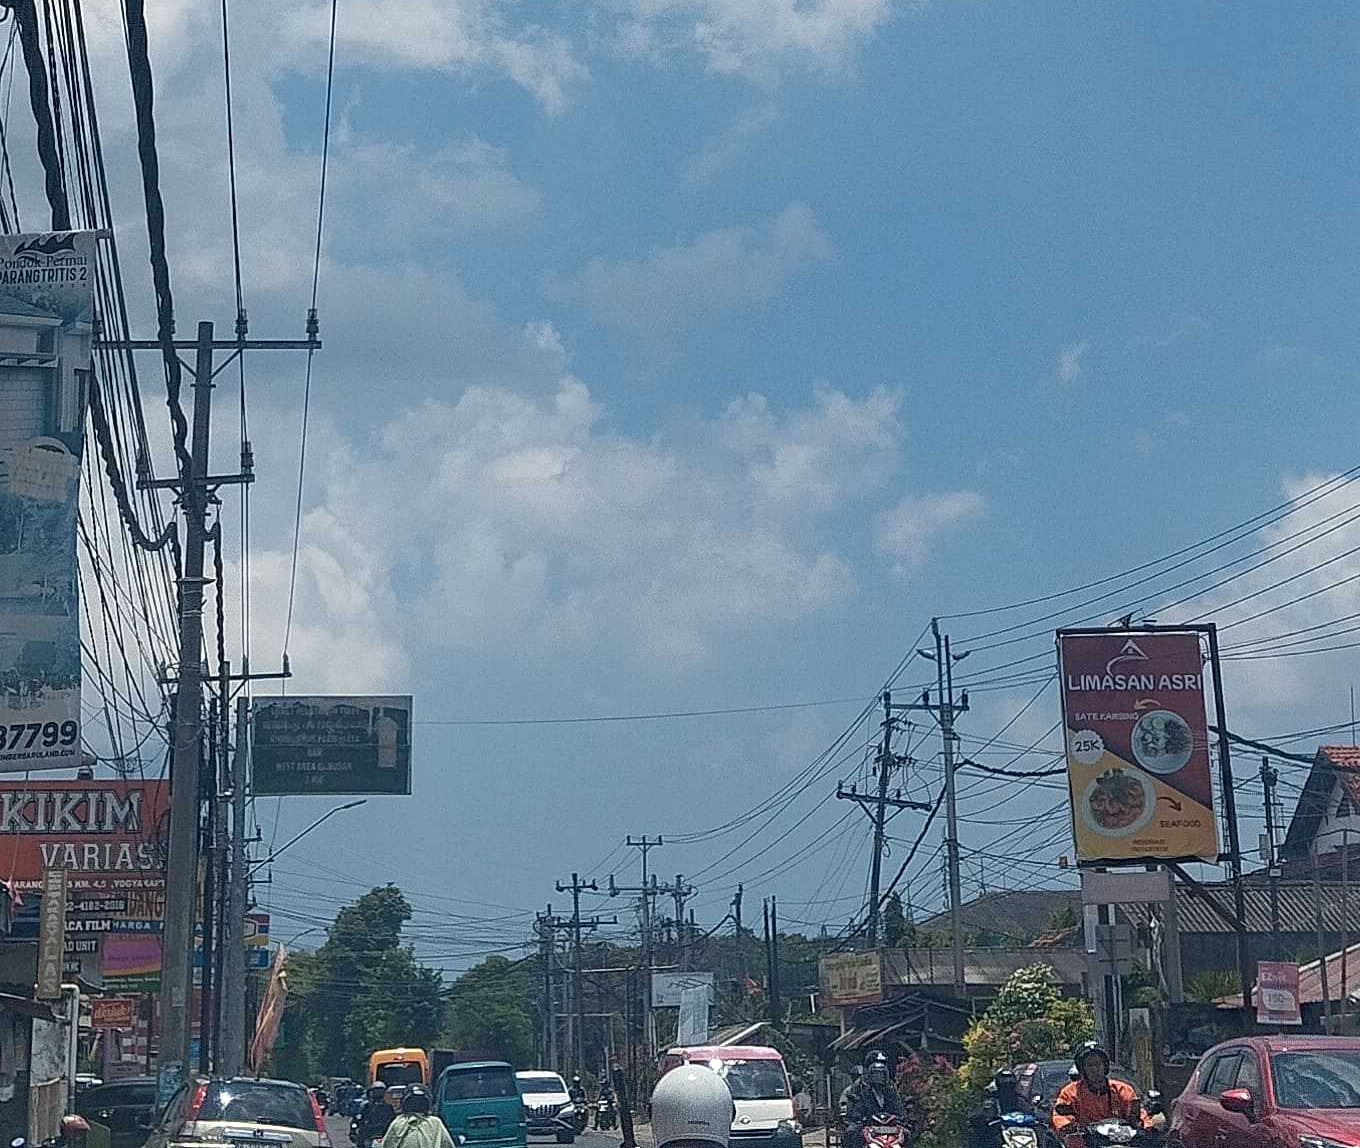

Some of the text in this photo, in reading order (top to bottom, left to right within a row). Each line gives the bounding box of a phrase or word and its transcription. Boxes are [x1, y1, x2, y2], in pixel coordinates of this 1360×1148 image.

[46, 253, 88, 268] Permai
[80, 266, 87, 281] 2
[1068, 674, 1201, 691] LIMASAN ASRI
[1075, 712, 1097, 721] SATE
[1075, 738, 1099, 752] 25K
[1160, 820, 1201, 828] SEAFOOD
[64, 920, 111, 932] ACA FILM
[112, 921, 151, 930] HARGA
[76, 940, 97, 952] UNIT
